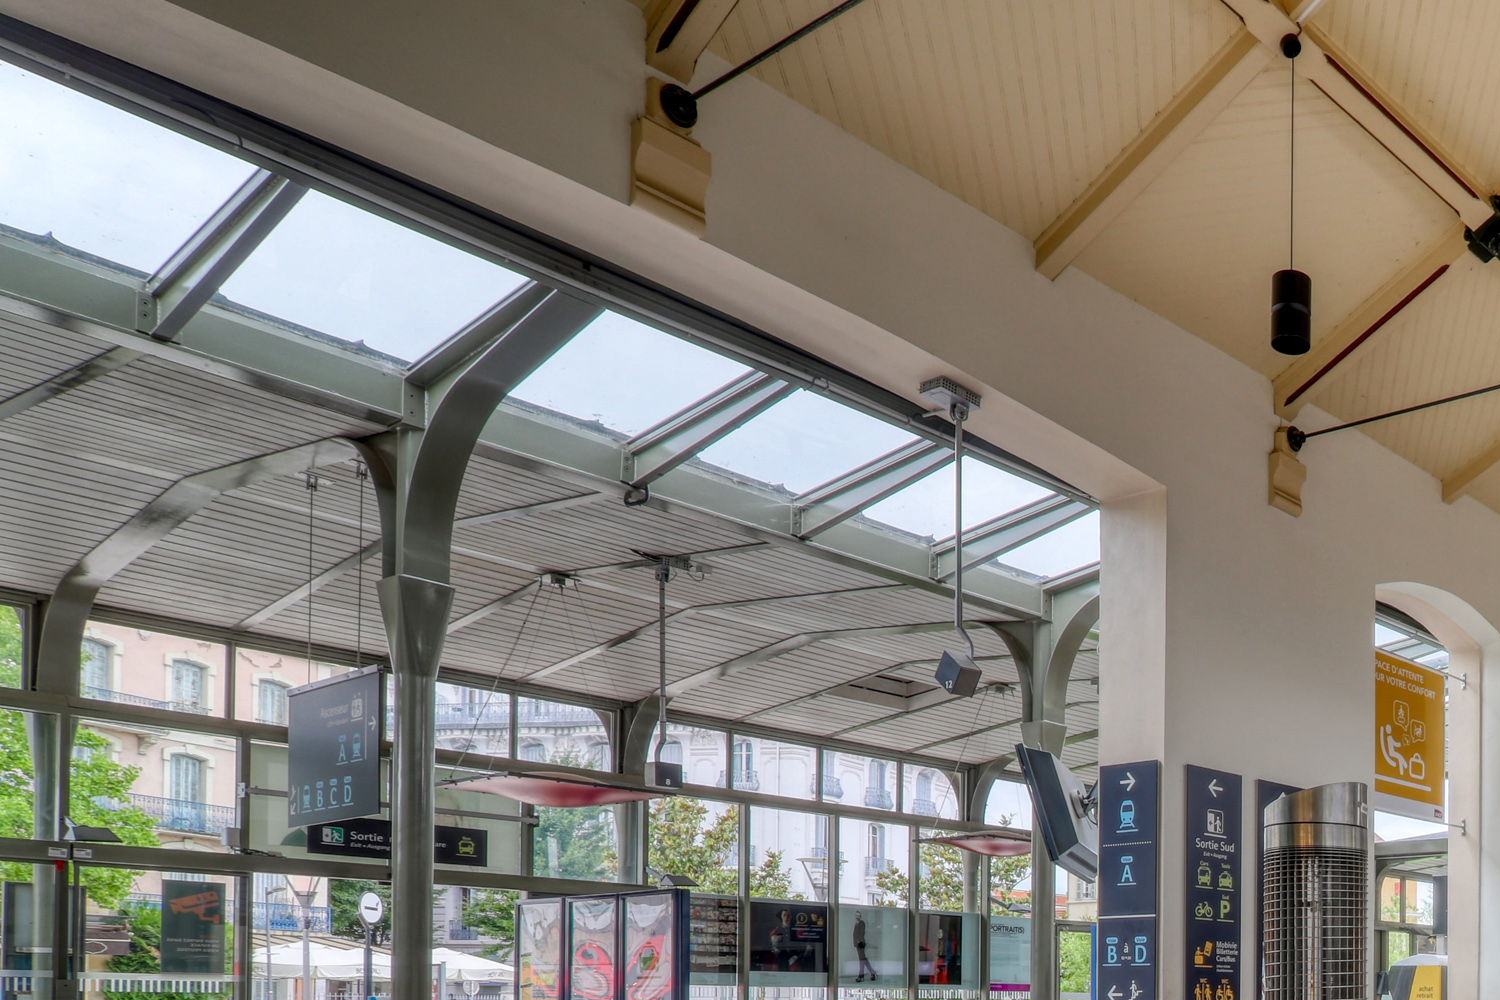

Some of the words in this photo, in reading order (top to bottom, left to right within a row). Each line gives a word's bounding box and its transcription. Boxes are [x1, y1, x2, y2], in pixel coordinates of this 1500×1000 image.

[1392, 664, 1424, 684] D'ATTENTE
[945, 680, 952, 689] 12
[1386, 675, 1406, 690] VOTRE
[1408, 682, 1436, 700] CONFORT
[338, 744, 346, 762] A
[316, 790, 324, 808] B
[330, 787, 337, 805] C
[344, 784, 352, 803] D
[350, 831, 384, 842] Sortie
[1196, 838, 1218, 851] Sortie
[1220, 842, 1234, 852] Sud
[1121, 865, 1132, 882] A
[1220, 900, 1230, 918] P
[1107, 946, 1117, 963] B
[1124, 943, 1128, 953] à
[1134, 944, 1146, 962] D
